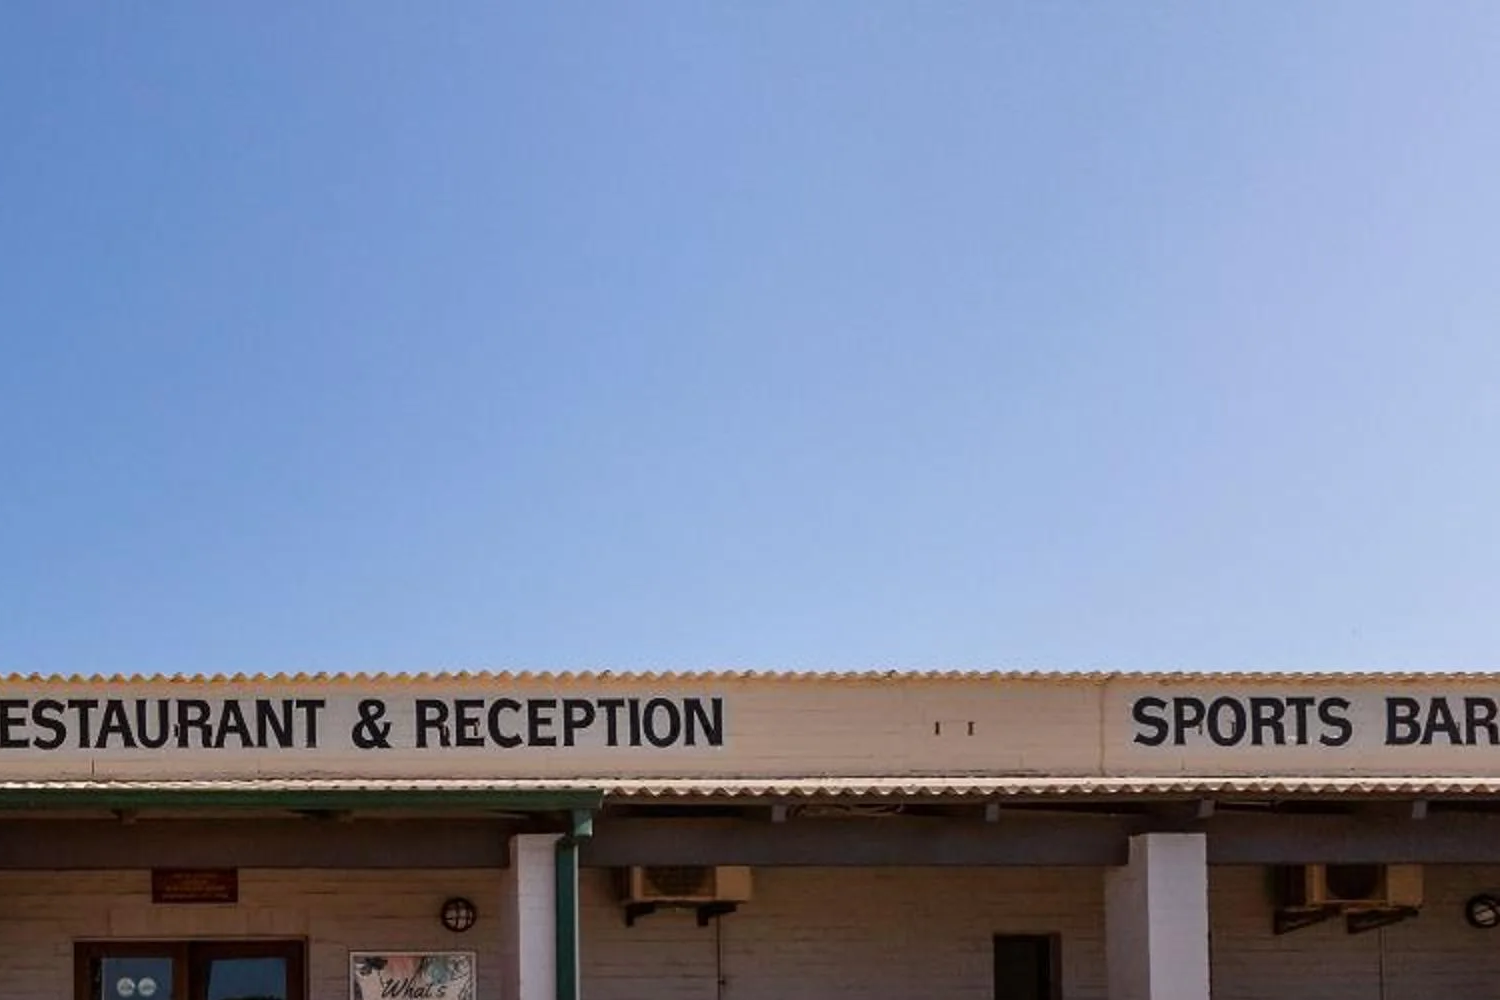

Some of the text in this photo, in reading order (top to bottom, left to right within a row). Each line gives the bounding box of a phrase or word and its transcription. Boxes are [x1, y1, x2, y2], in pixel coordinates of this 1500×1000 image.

[351, 698, 392, 750] &
[415, 697, 723, 749] RECEPTION
[1131, 696, 1500, 747] SPORTS BAR
[381, 978, 447, 999] What's
